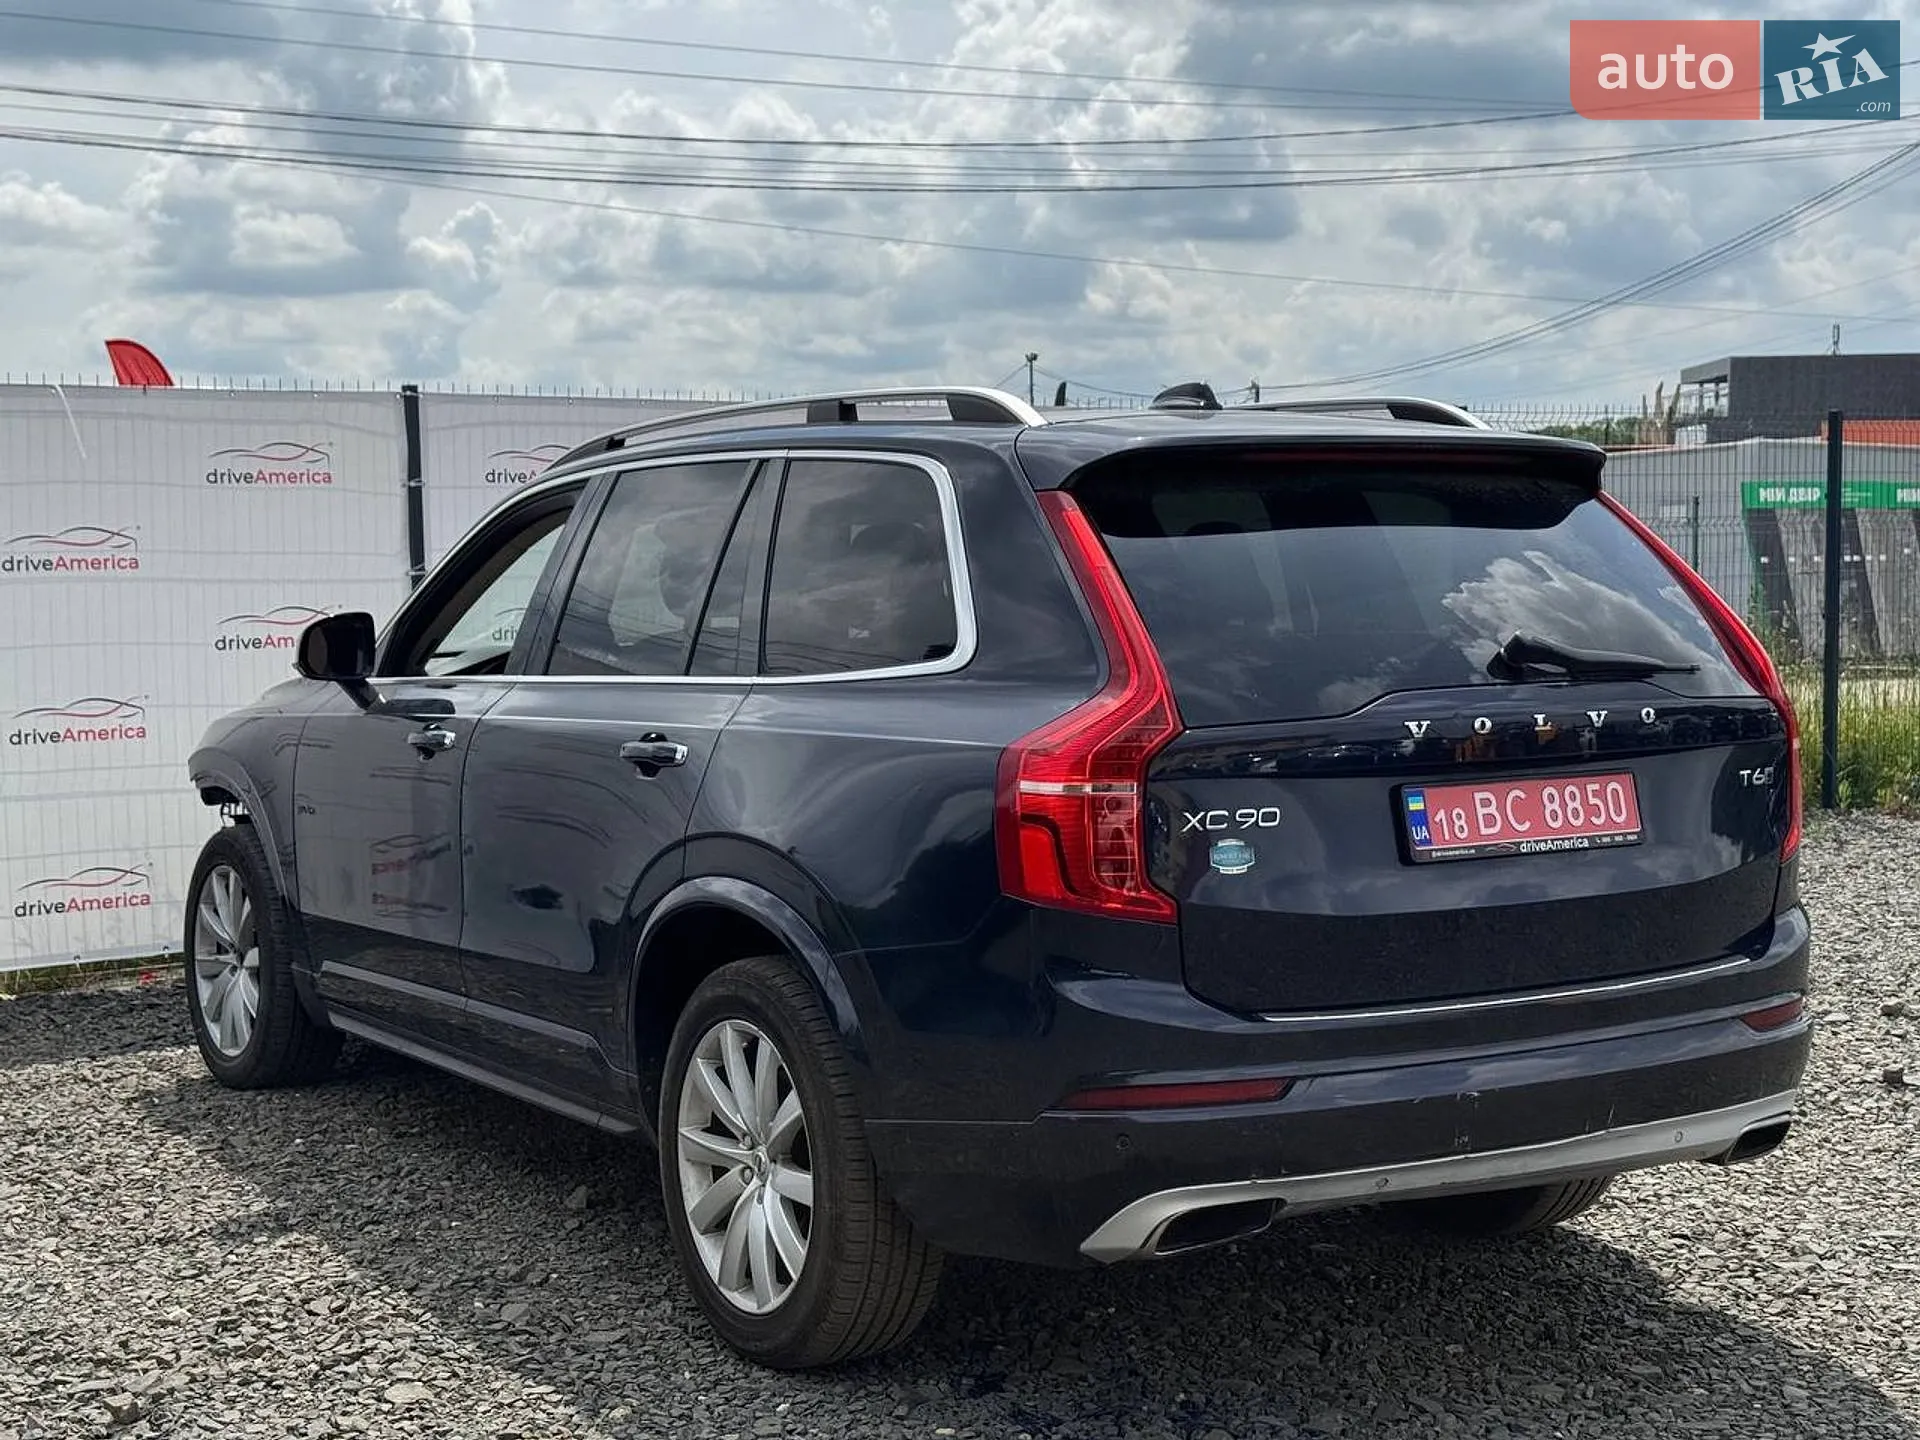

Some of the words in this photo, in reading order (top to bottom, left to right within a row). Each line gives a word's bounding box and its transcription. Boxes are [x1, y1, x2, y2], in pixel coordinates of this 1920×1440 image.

[206, 468, 332, 484] driveAmerica
[485, 468, 537, 483] driveA
[1, 554, 139, 572] driveAmerica
[214, 634, 295, 651] driveAm
[1404, 706, 1657, 739] VOLVO
[9, 724, 147, 746] driveAmerica
[1434, 807, 1469, 841] 18
[1473, 788, 1532, 836] BC
[1541, 780, 1628, 830] 8850
[1411, 824, 1430, 841] UA
[1519, 836, 1590, 853] driveAmerica
[14, 892, 152, 918] driveAmerica
